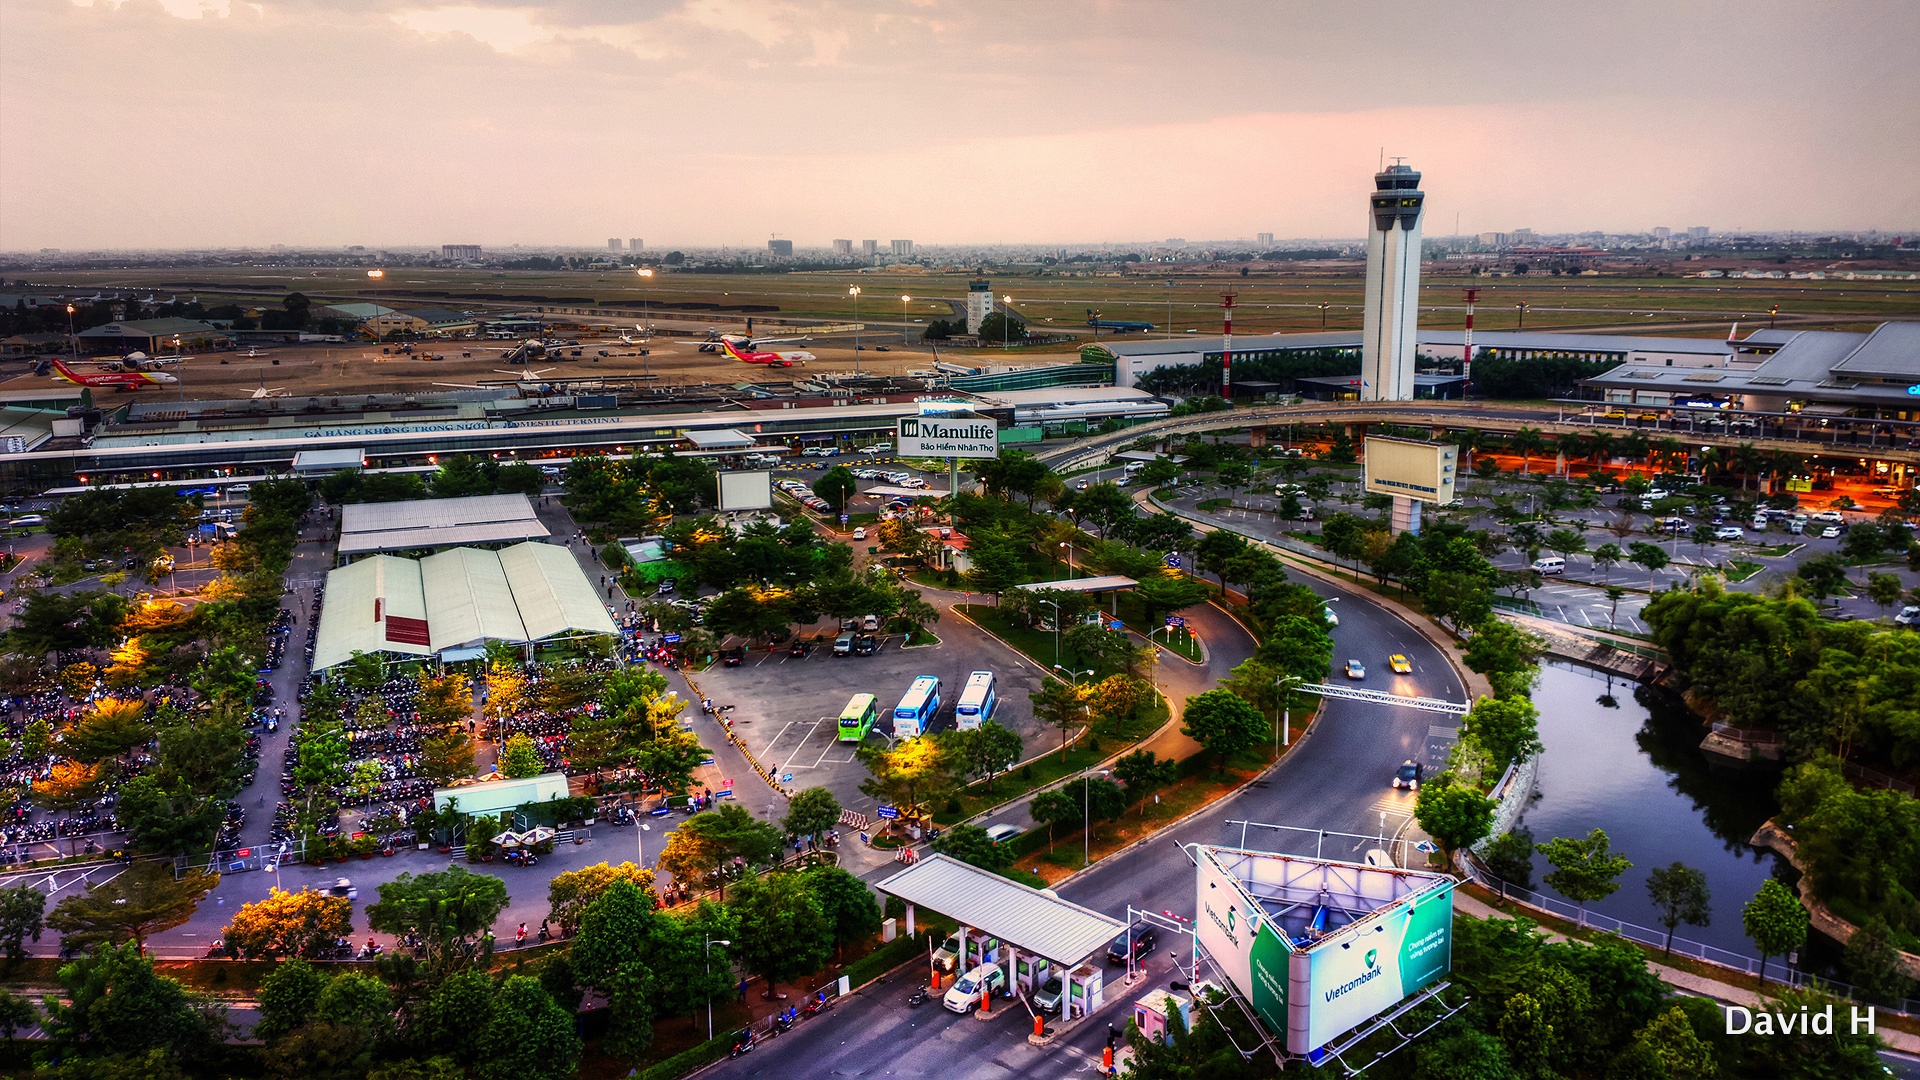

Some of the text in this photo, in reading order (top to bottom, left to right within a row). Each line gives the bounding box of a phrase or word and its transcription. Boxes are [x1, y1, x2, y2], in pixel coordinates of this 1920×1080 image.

[325, 427, 361, 437] HÀNG
[566, 417, 623, 425] TERMINAL
[921, 423, 994, 439] Manulife
[920, 443, 935, 451] Bảo
[979, 444, 994, 453] Thọ
[1204, 901, 1239, 950] Vietcombank
[1325, 965, 1382, 1003] Vietcombank
